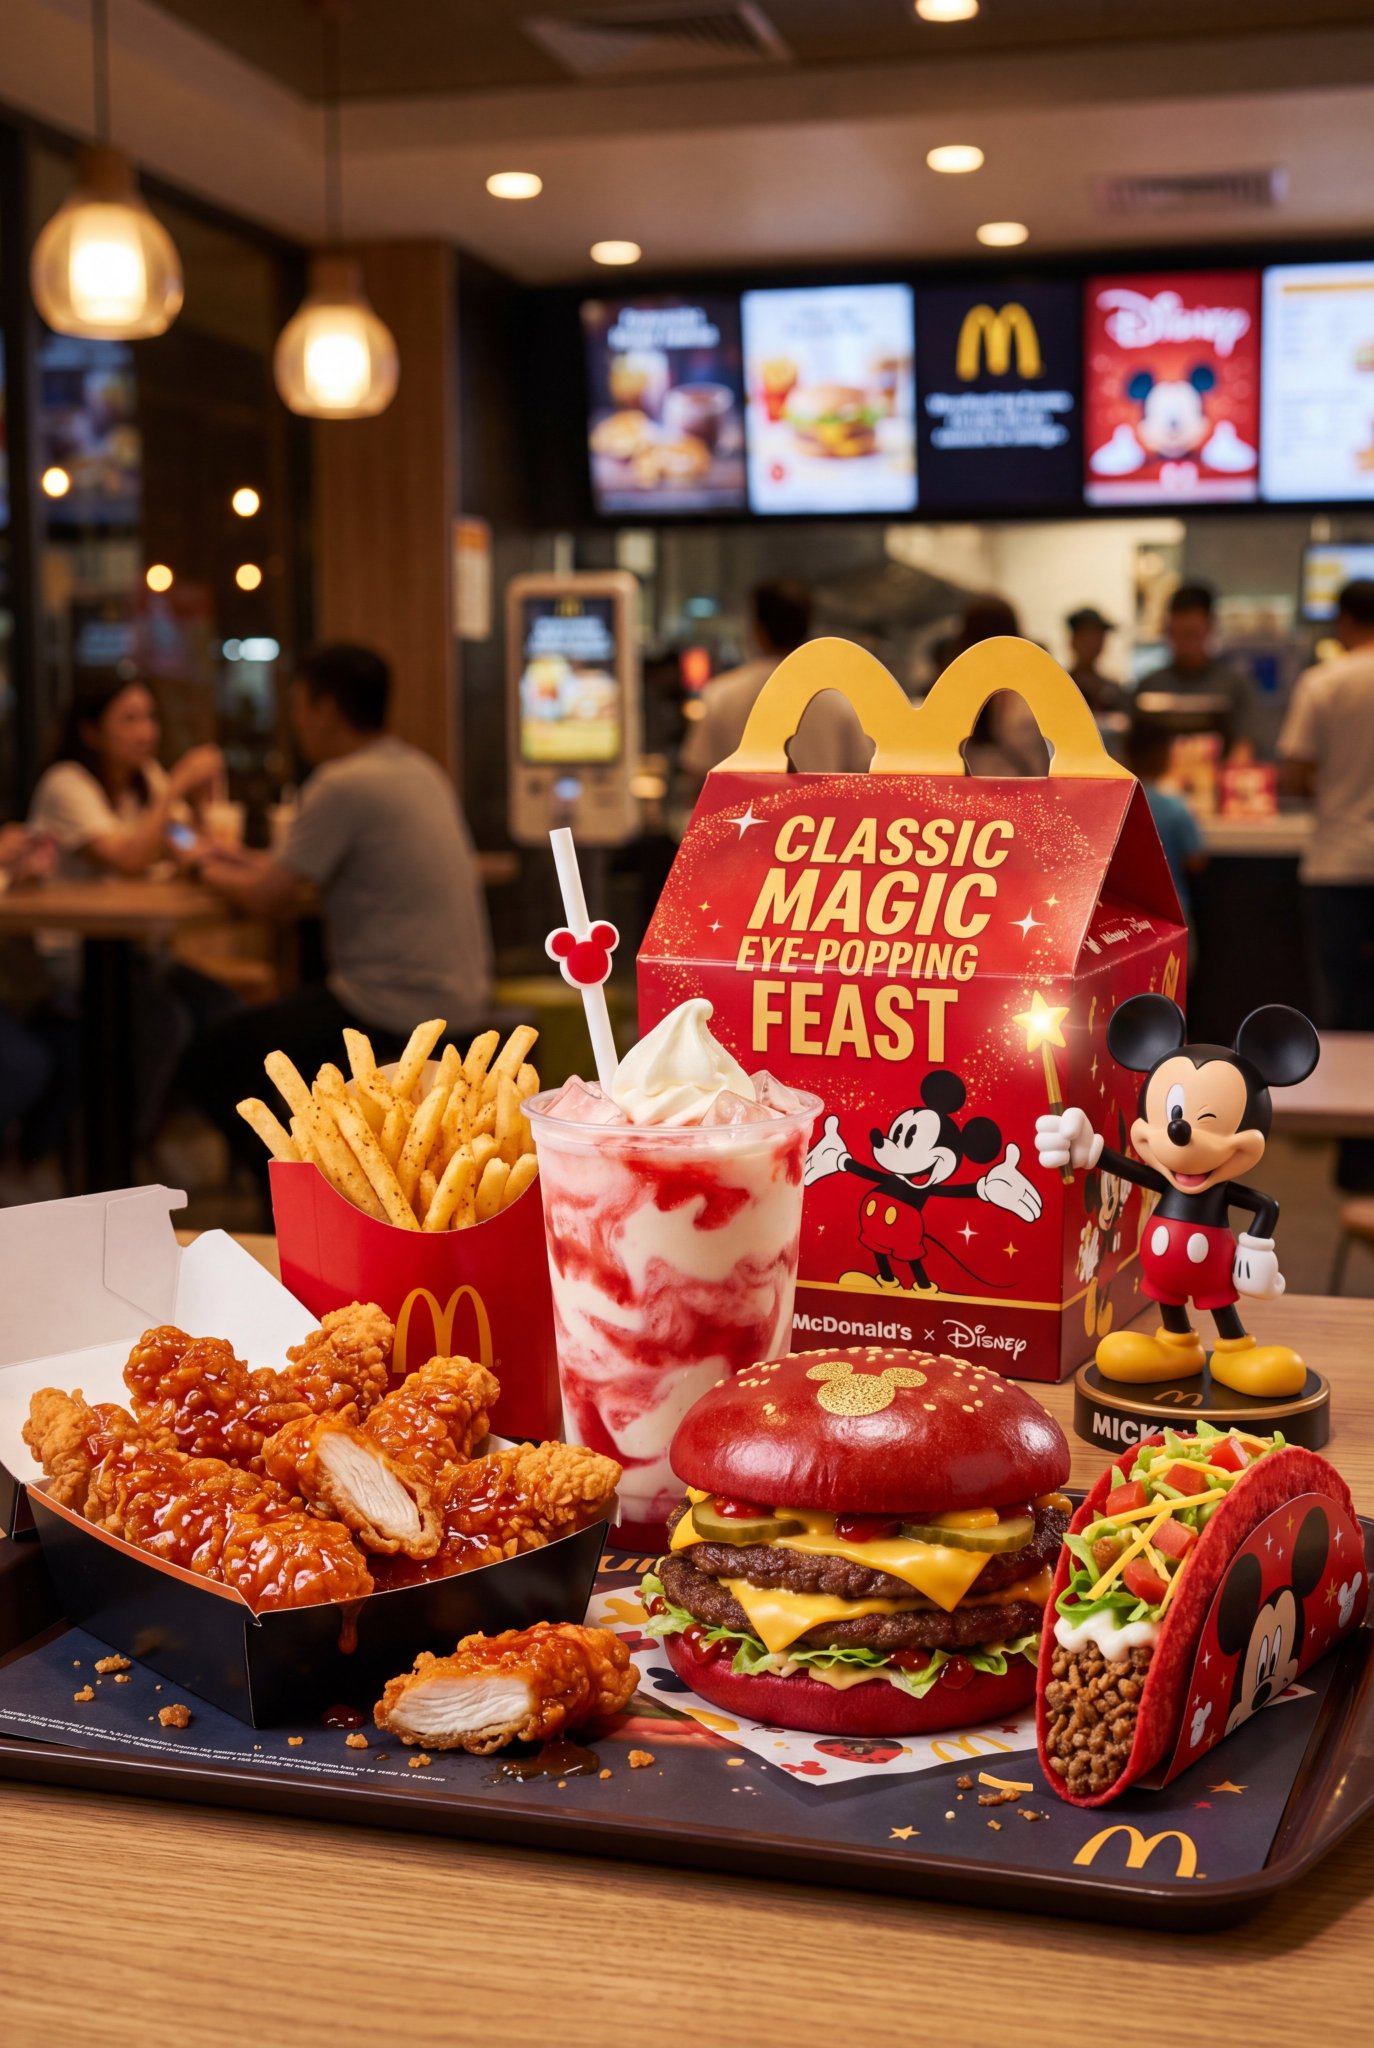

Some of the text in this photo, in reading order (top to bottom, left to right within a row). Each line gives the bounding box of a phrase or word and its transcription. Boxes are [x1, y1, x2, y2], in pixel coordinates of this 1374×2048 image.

[775, 816, 1015, 868] CLASSIC
[747, 869, 997, 938] MAGIC
[737, 937, 978, 981] EYE-POPPING
[753, 981, 959, 1062] FEAST
[792, 1313, 912, 1341] McDonald's
